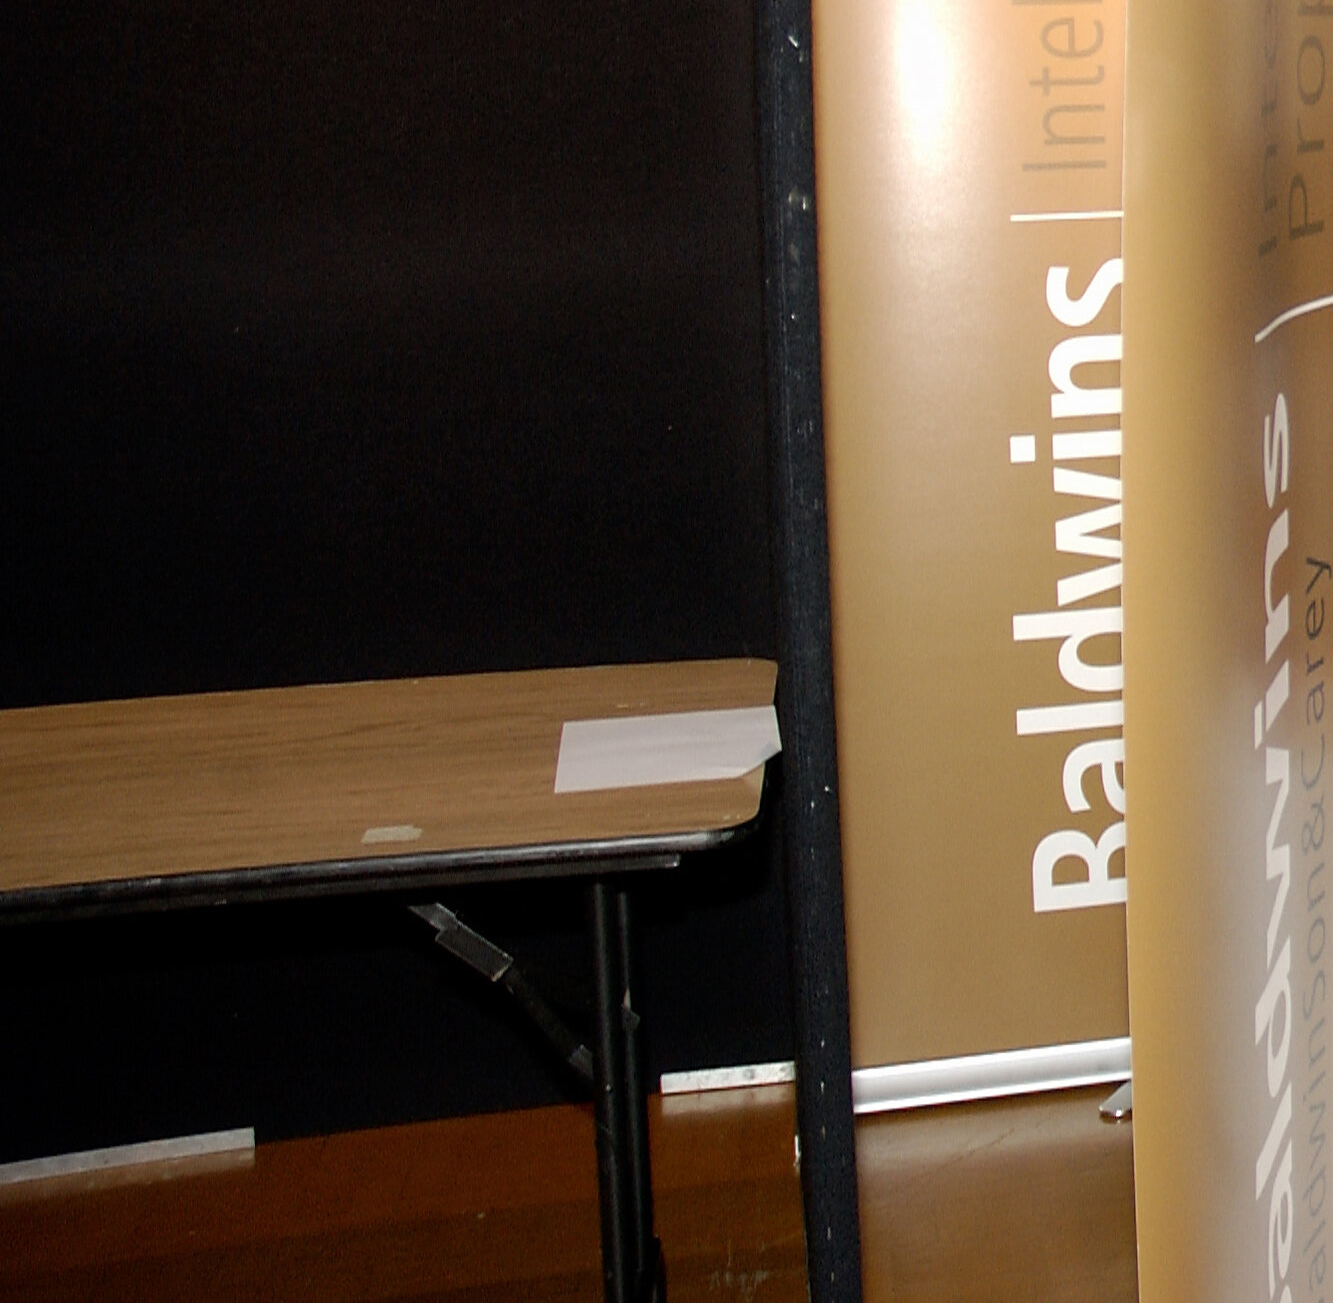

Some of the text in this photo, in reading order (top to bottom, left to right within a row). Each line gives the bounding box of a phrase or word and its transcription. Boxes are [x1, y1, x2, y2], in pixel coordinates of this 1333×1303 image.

[1010, 255, 1128, 914] Baldwins
[1253, 392, 1294, 1302] aldwins
[1301, 555, 1333, 1302] aldwinSon&Carey
